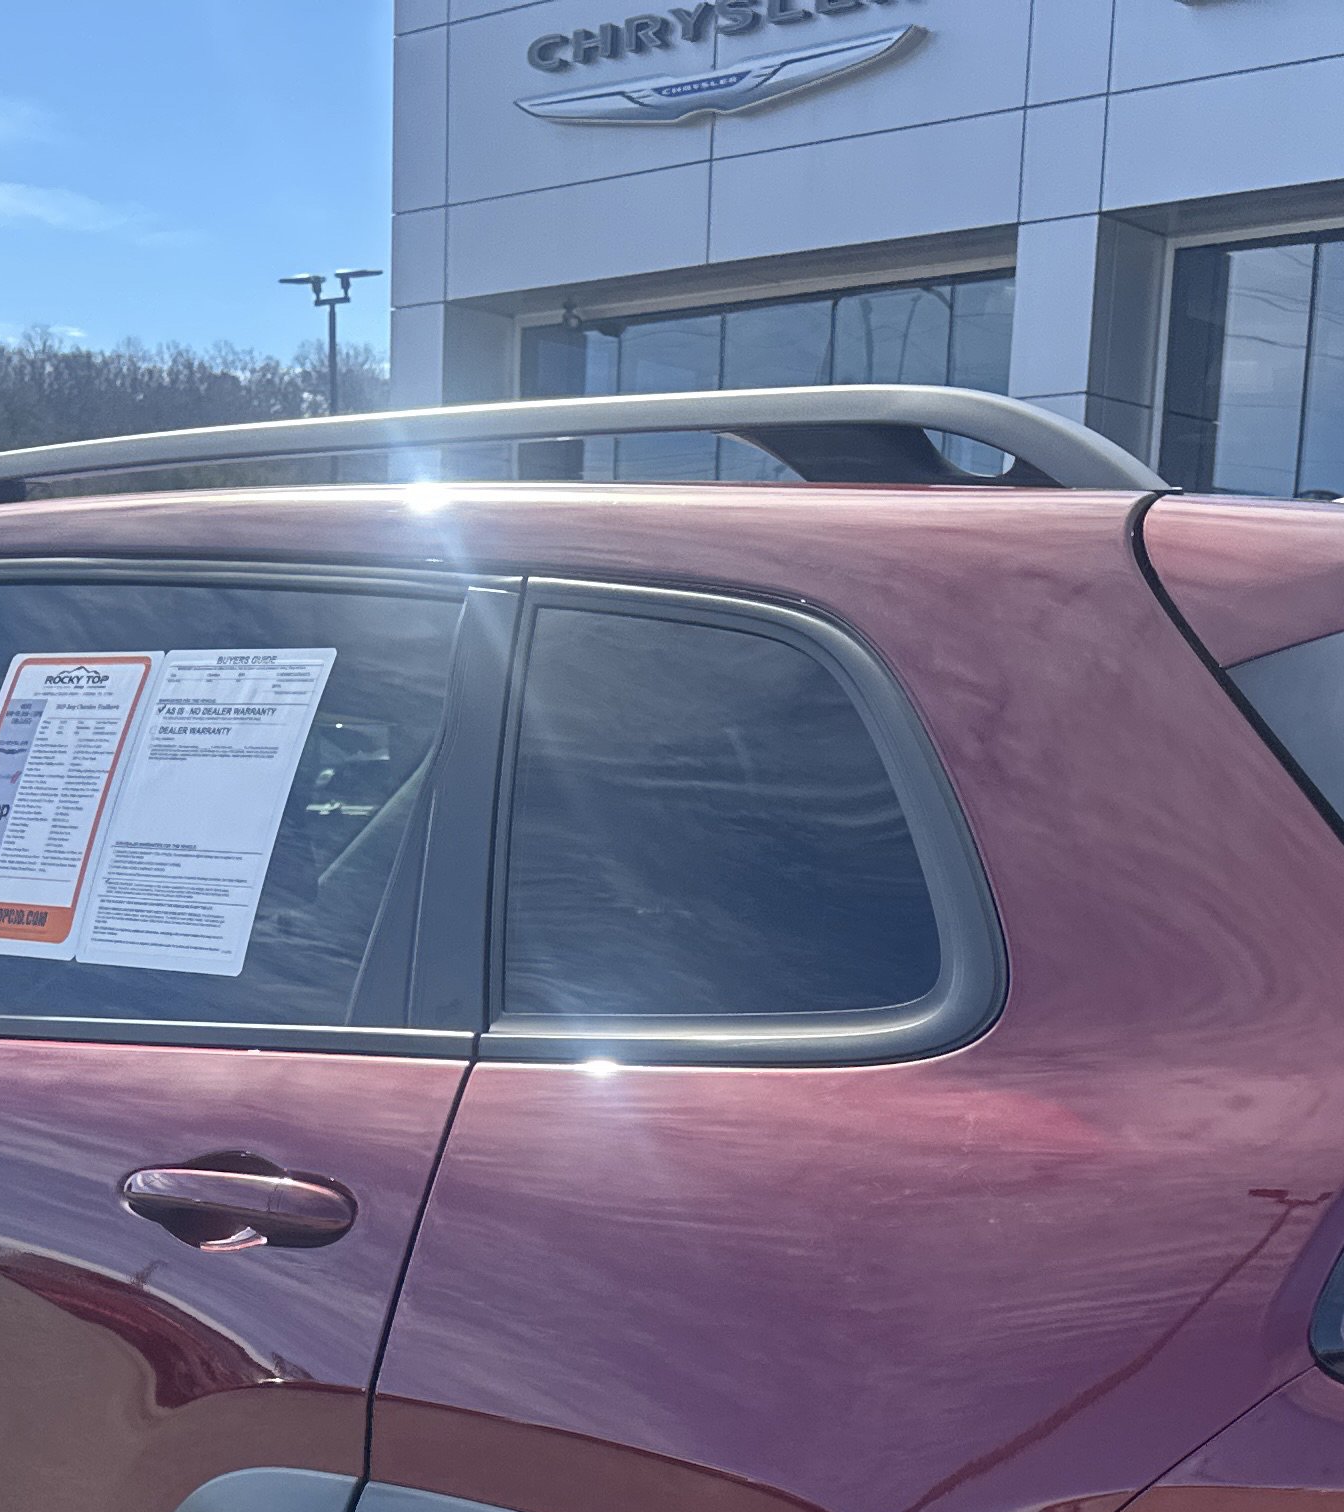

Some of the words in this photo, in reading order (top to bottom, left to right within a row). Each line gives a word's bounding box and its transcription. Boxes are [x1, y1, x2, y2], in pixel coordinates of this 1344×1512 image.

[527, 0, 898, 71] CHRYSL
[216, 656, 250, 665] BUYERS
[251, 655, 277, 664] GUIDE
[44, 675, 84, 685] ROCKY
[85, 675, 110, 685] TOP
[202, 707, 233, 715] DEALER
[233, 707, 276, 716] WARRANTY
[158, 726, 188, 735] DEALER
[189, 727, 232, 735] WARRANTY
